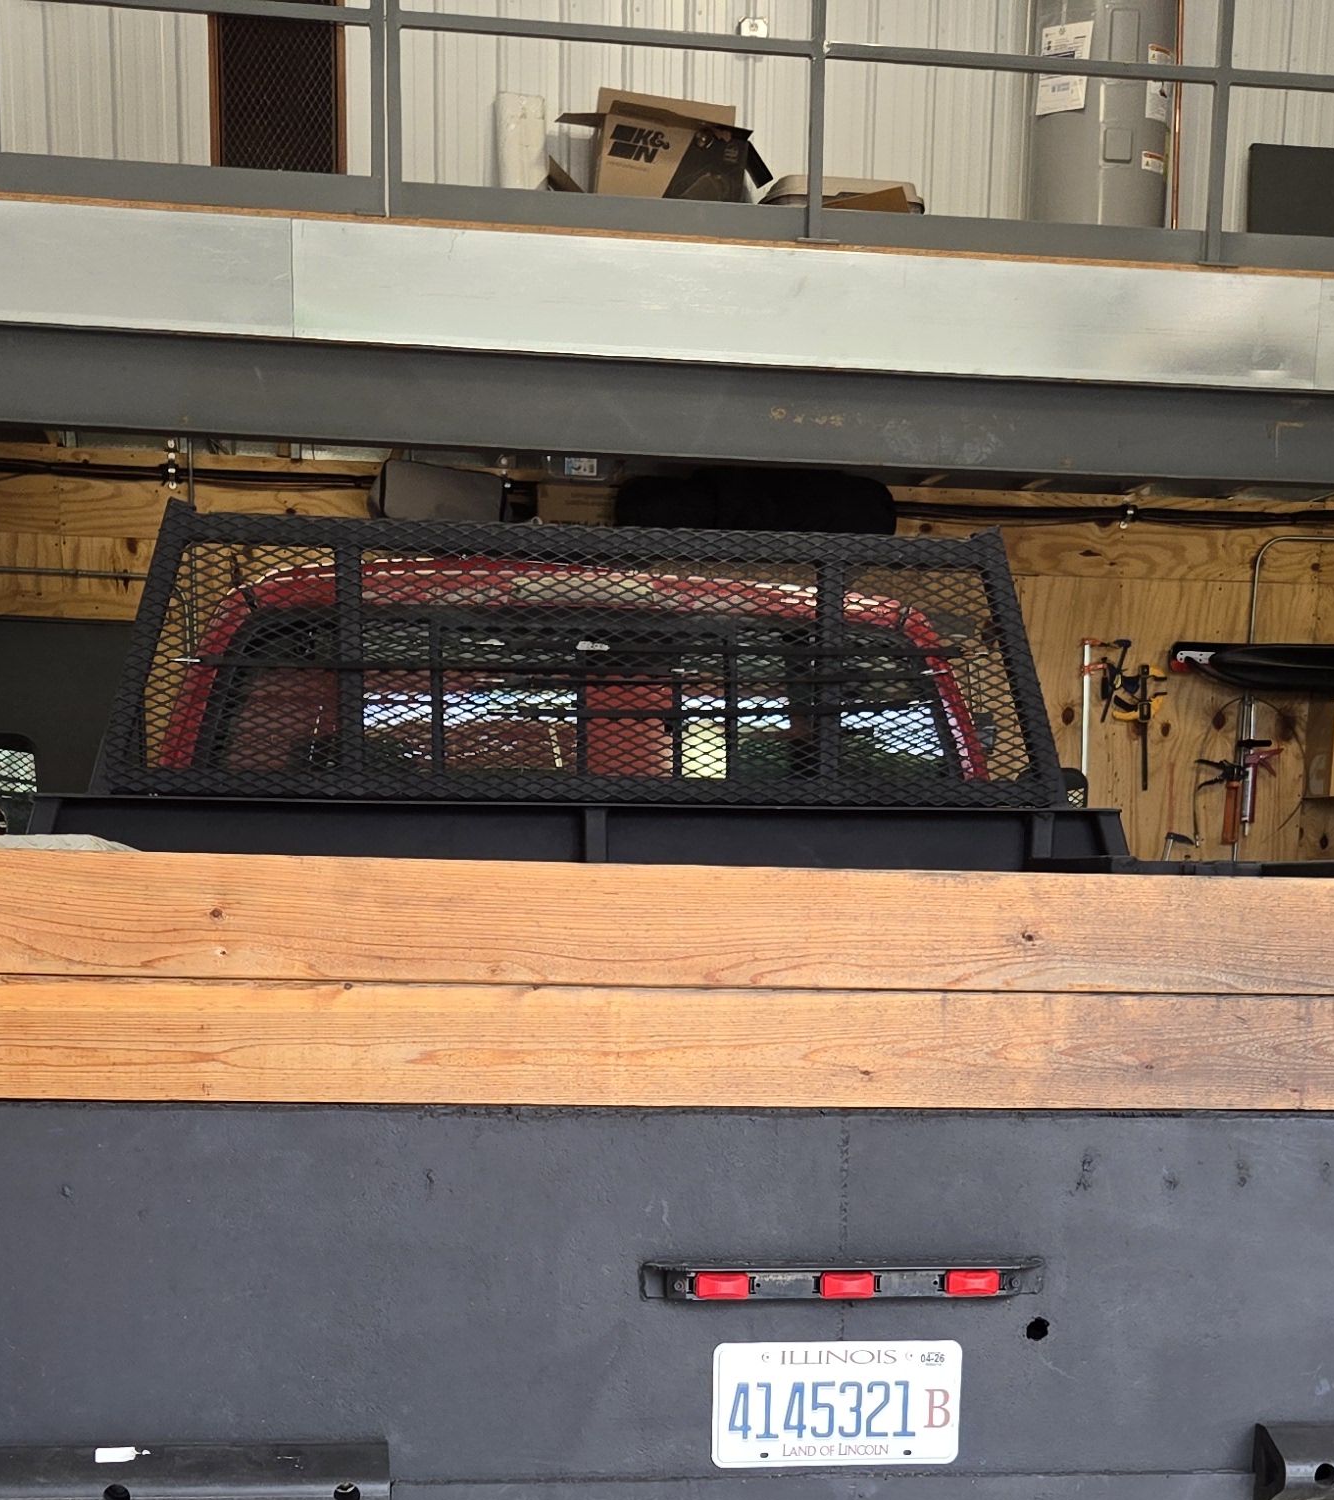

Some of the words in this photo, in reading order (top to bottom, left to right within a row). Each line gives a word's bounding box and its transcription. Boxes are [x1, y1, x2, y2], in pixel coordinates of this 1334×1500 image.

[780, 1349, 898, 1365] ILLINOIS
[920, 1353, 945, 1363] 04-26
[728, 1380, 916, 1440] 4145321
[923, 1388, 951, 1429] B
